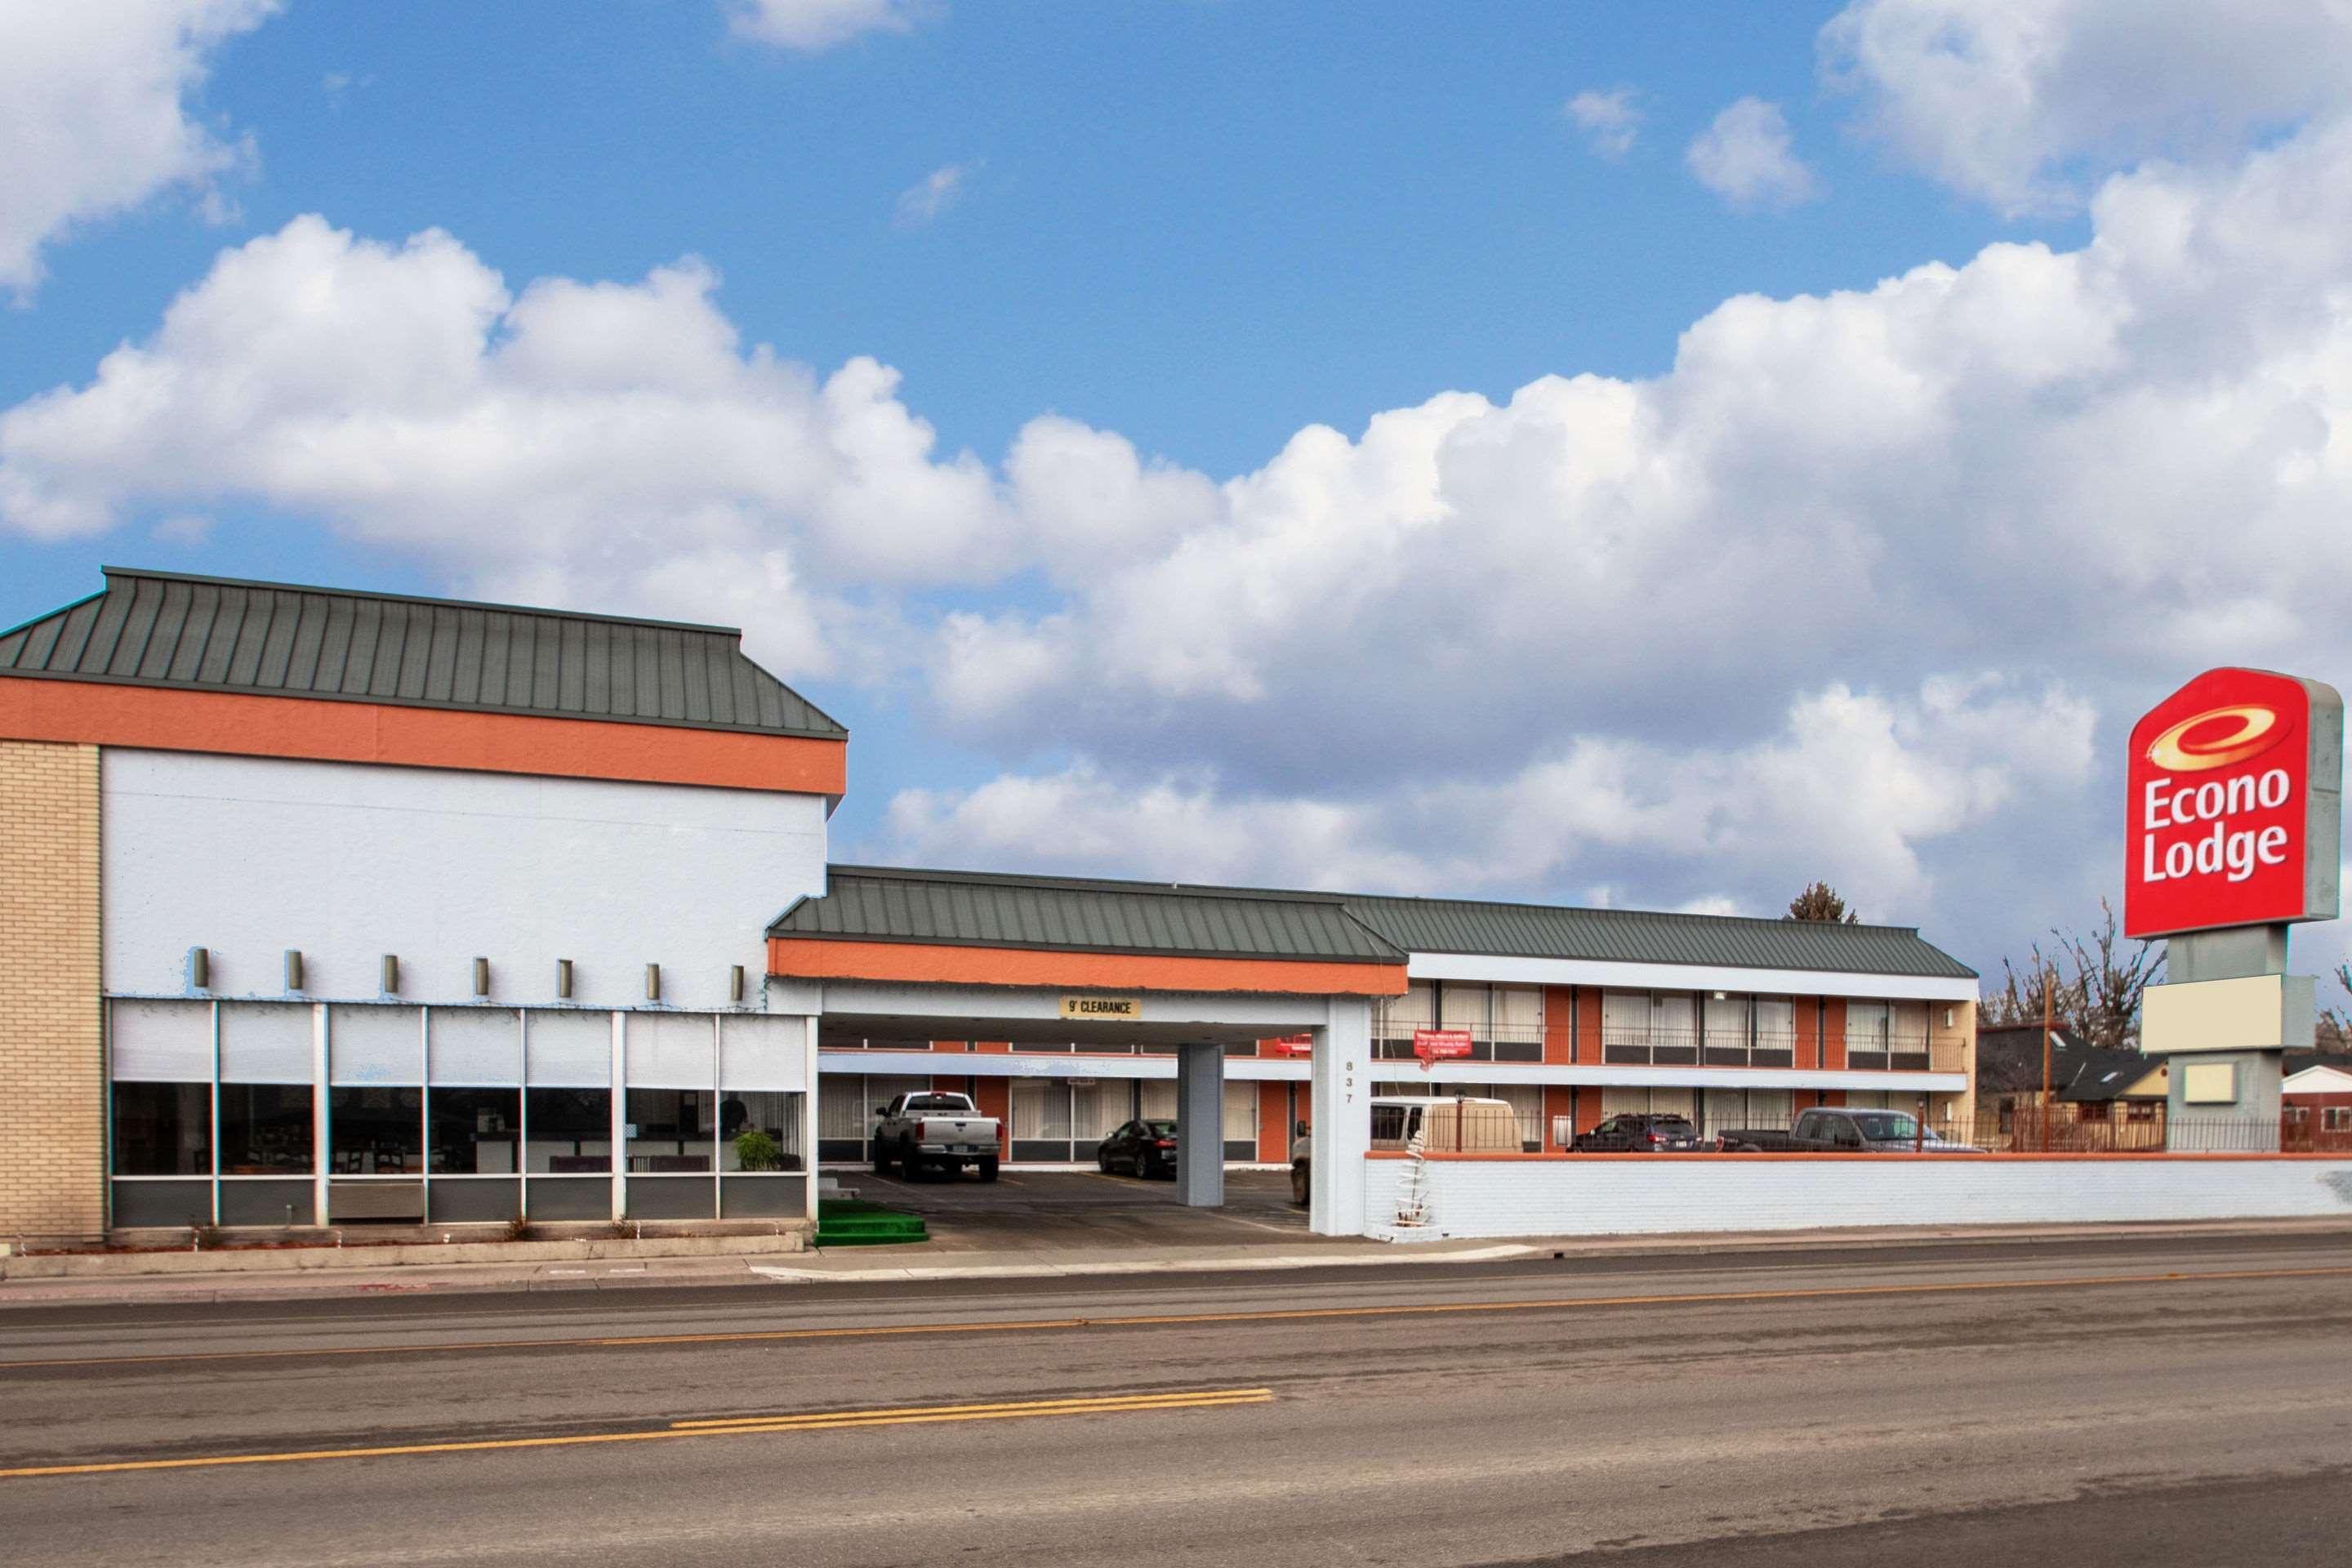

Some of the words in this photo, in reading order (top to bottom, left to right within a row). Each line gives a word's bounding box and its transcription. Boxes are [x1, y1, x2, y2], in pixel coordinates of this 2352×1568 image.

[2145, 768, 2290, 830] Econo
[2144, 821, 2287, 883] Lodge
[1080, 1000, 1132, 1014] CLEARANCE
